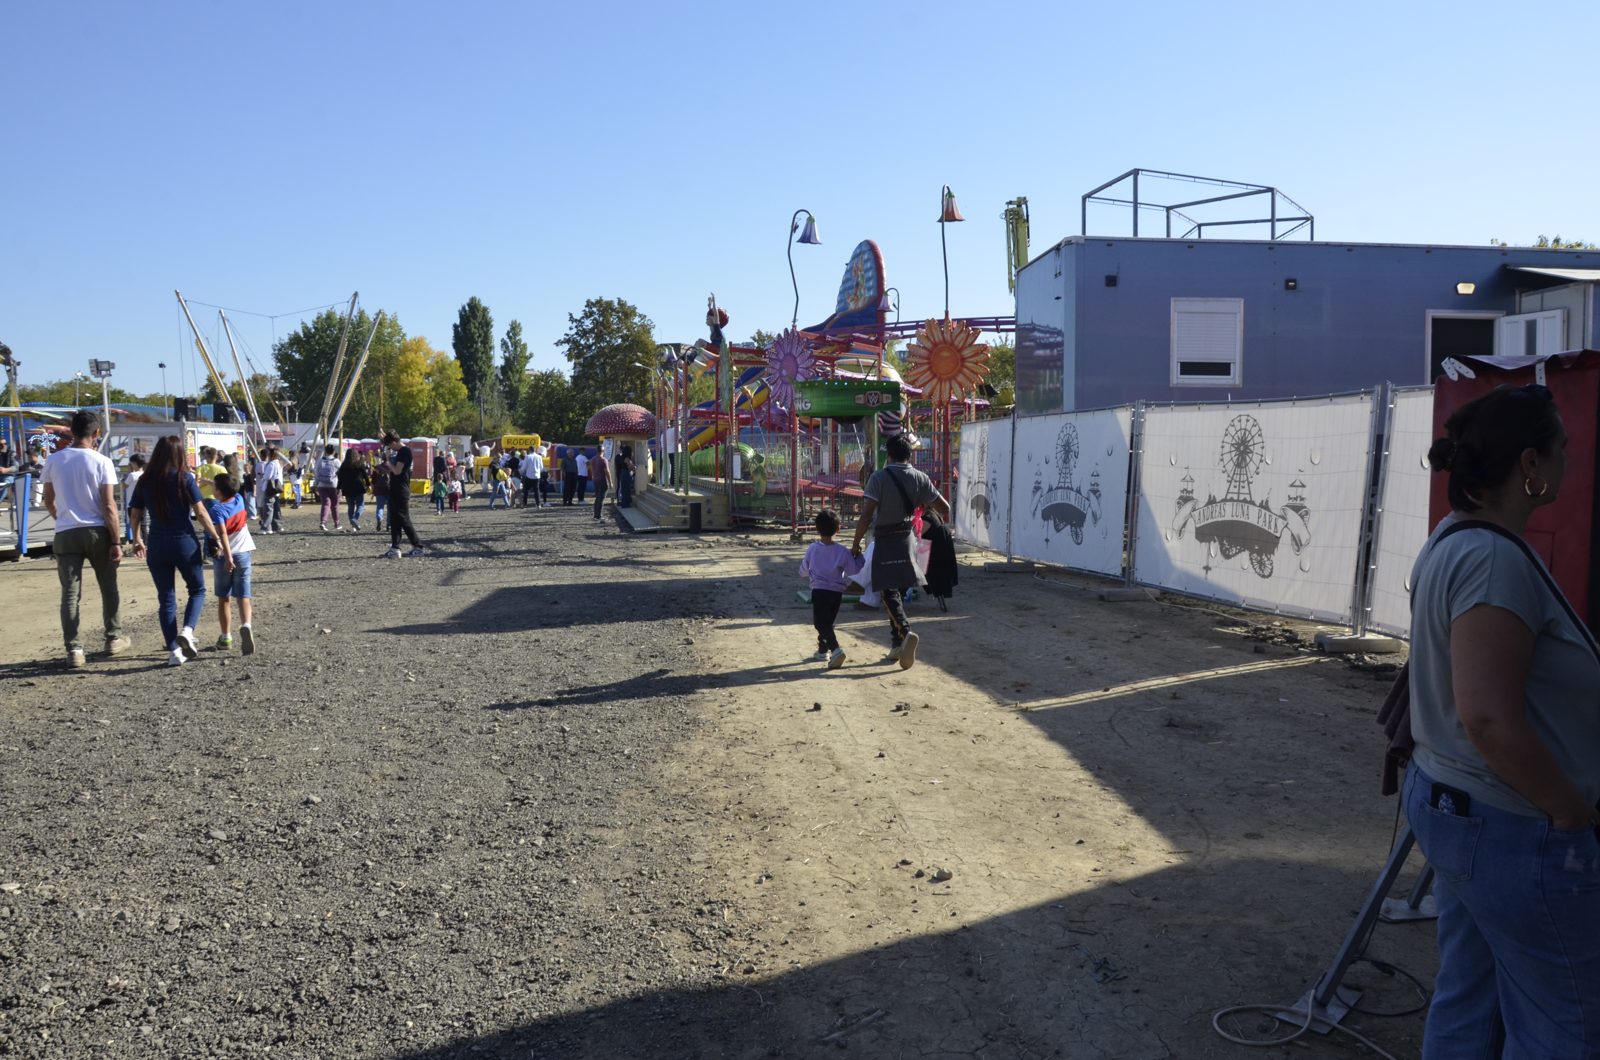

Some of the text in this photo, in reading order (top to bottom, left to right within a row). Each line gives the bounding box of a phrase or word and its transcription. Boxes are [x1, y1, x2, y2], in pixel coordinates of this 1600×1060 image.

[506, 438, 536, 446] RODEO
[1196, 502, 1279, 533] ANDREAS LUNA PARK
